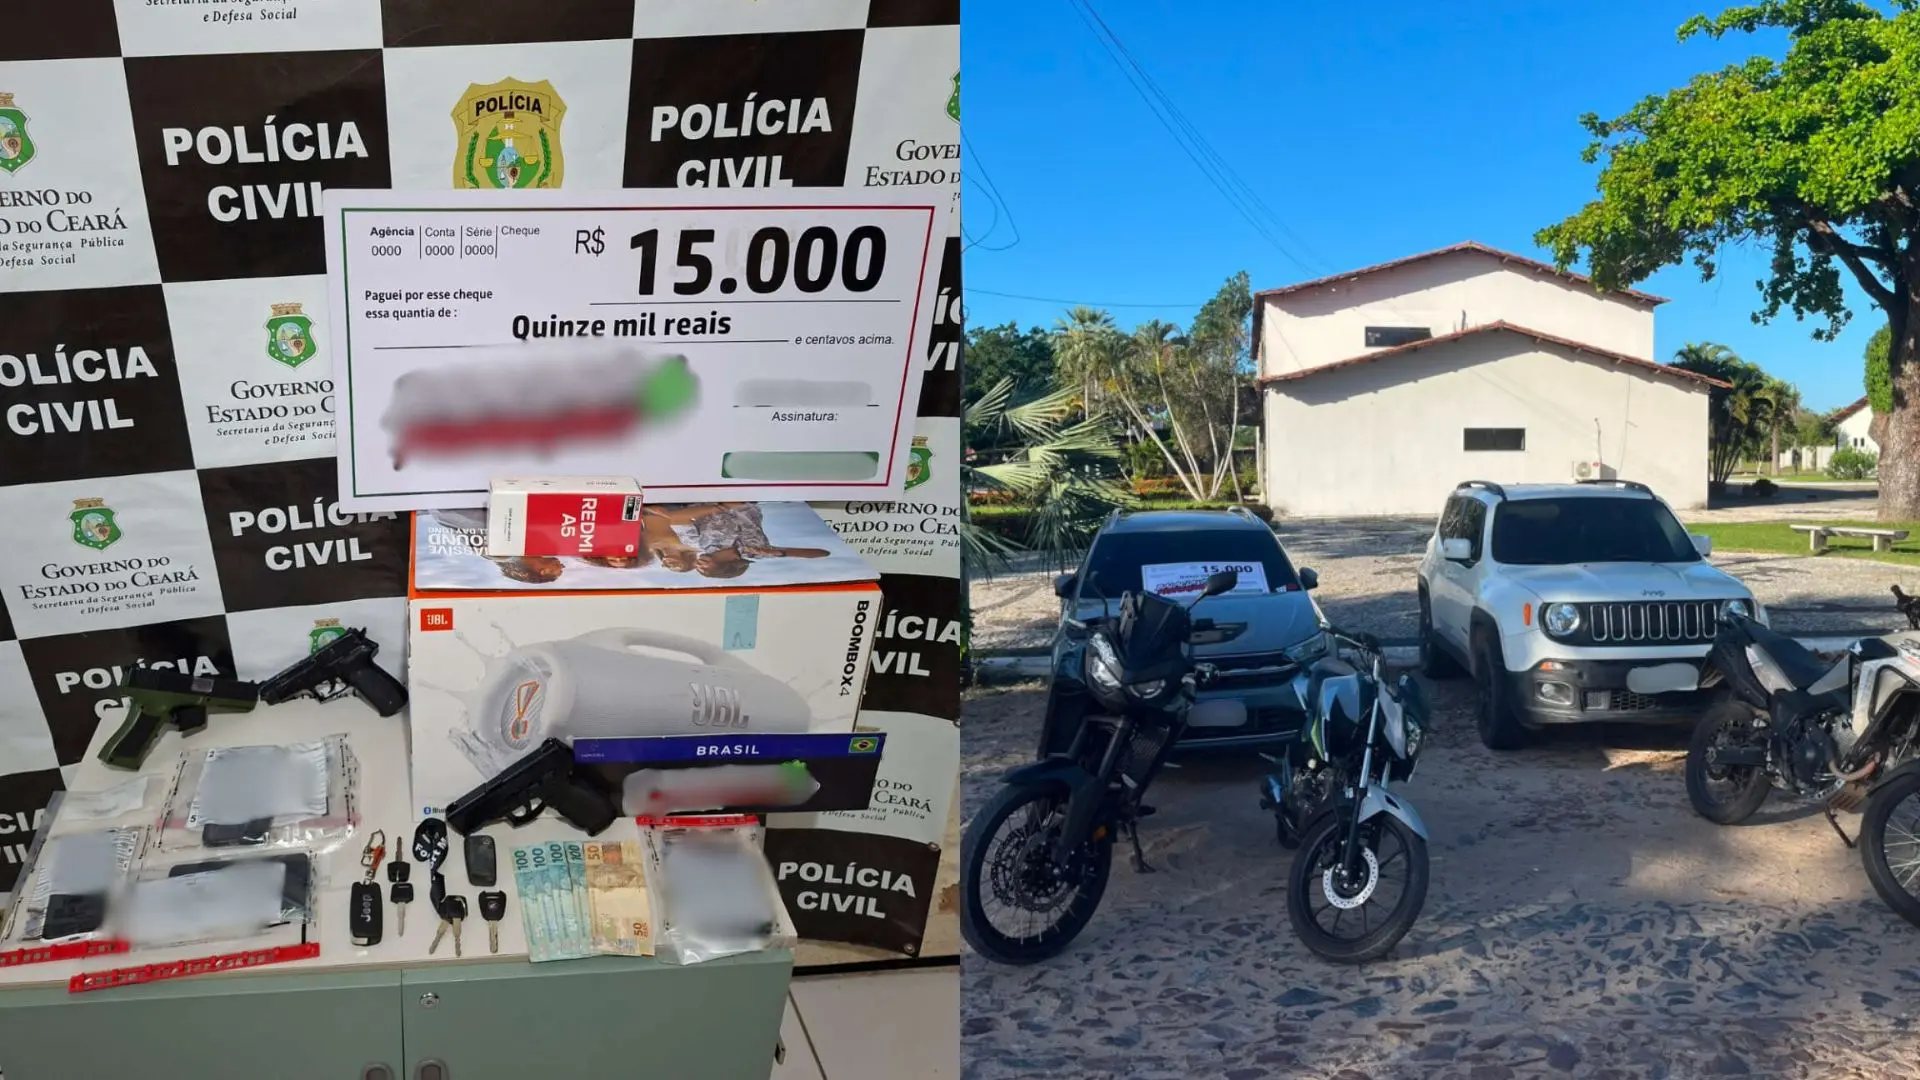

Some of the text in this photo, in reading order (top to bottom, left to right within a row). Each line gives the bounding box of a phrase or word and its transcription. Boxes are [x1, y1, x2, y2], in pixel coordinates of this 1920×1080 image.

[213, 10, 252, 24] Defesa
[260, 8, 296, 20] Social
[476, 92, 542, 116] POLÍCIA
[650, 92, 832, 142] POLÍCIA
[162, 116, 368, 166] POLÍCIA
[676, 156, 794, 188] CIVIL
[864, 166, 946, 186] ESTADO
[66, 191, 92, 204] DO
[16, 220, 42, 234] DO
[47, 208, 128, 232] CEARÁ
[370, 225, 540, 238] Agência Conta Série Cheque
[12, 240, 72, 253] Segurança
[80, 237, 124, 248] Pública
[372, 245, 494, 256] 0000 0000 0000
[41, 254, 76, 265] Social
[575, 226, 888, 296] R$ 15.000
[365, 288, 492, 302] Paguei por esse cheque
[366, 310, 389, 318] essa
[393, 308, 434, 320] quantia
[438, 308, 451, 318] de
[512, 312, 731, 342] Quinze mil reais
[795, 334, 894, 345] e centavos acima.
[231, 380, 334, 400] GOVERNO
[6, 398, 134, 436] CIVIL
[206, 405, 316, 424] ESTADO DO
[772, 410, 838, 422] Assinatura:
[216, 419, 336, 436] Secretaria da Seguranç
[272, 433, 306, 446] Defesa
[846, 501, 937, 516] GOVERNO
[561, 514, 576, 538] A5
[578, 498, 598, 552] REDMI
[893, 524, 914, 532] DO
[428, 534, 488, 546] OUND
[870, 536, 882, 544] da
[884, 537, 934, 546] Segurança
[265, 538, 372, 571] CIVIL
[867, 547, 898, 556] Defesa
[903, 548, 934, 556] Social
[42, 556, 170, 580] GOVERNO DO
[20, 565, 200, 600] ESTADO DO CEARÁ
[32, 585, 196, 610] Secretaria da Segurança Pública
[88, 606, 120, 614] Defesa
[126, 600, 156, 609] Social
[427, 614, 448, 625] JBL
[875, 609, 960, 646] ÍCIA
[870, 650, 930, 677] VIL
[689, 682, 750, 728] JBL
[696, 744, 760, 756] BRASIL
[893, 782, 912, 792] DO
[874, 790, 932, 813] CEARÁ
[860, 813, 886, 822] Social
[514, 850, 528, 870] 100
[532, 848, 546, 868] 100
[550, 844, 564, 863] 100
[568, 844, 582, 861] 100
[588, 846, 600, 860] 50
[778, 856, 916, 898] POLÍCIA
[797, 891, 886, 919] CIVIL
[633, 922, 642, 936] 50
